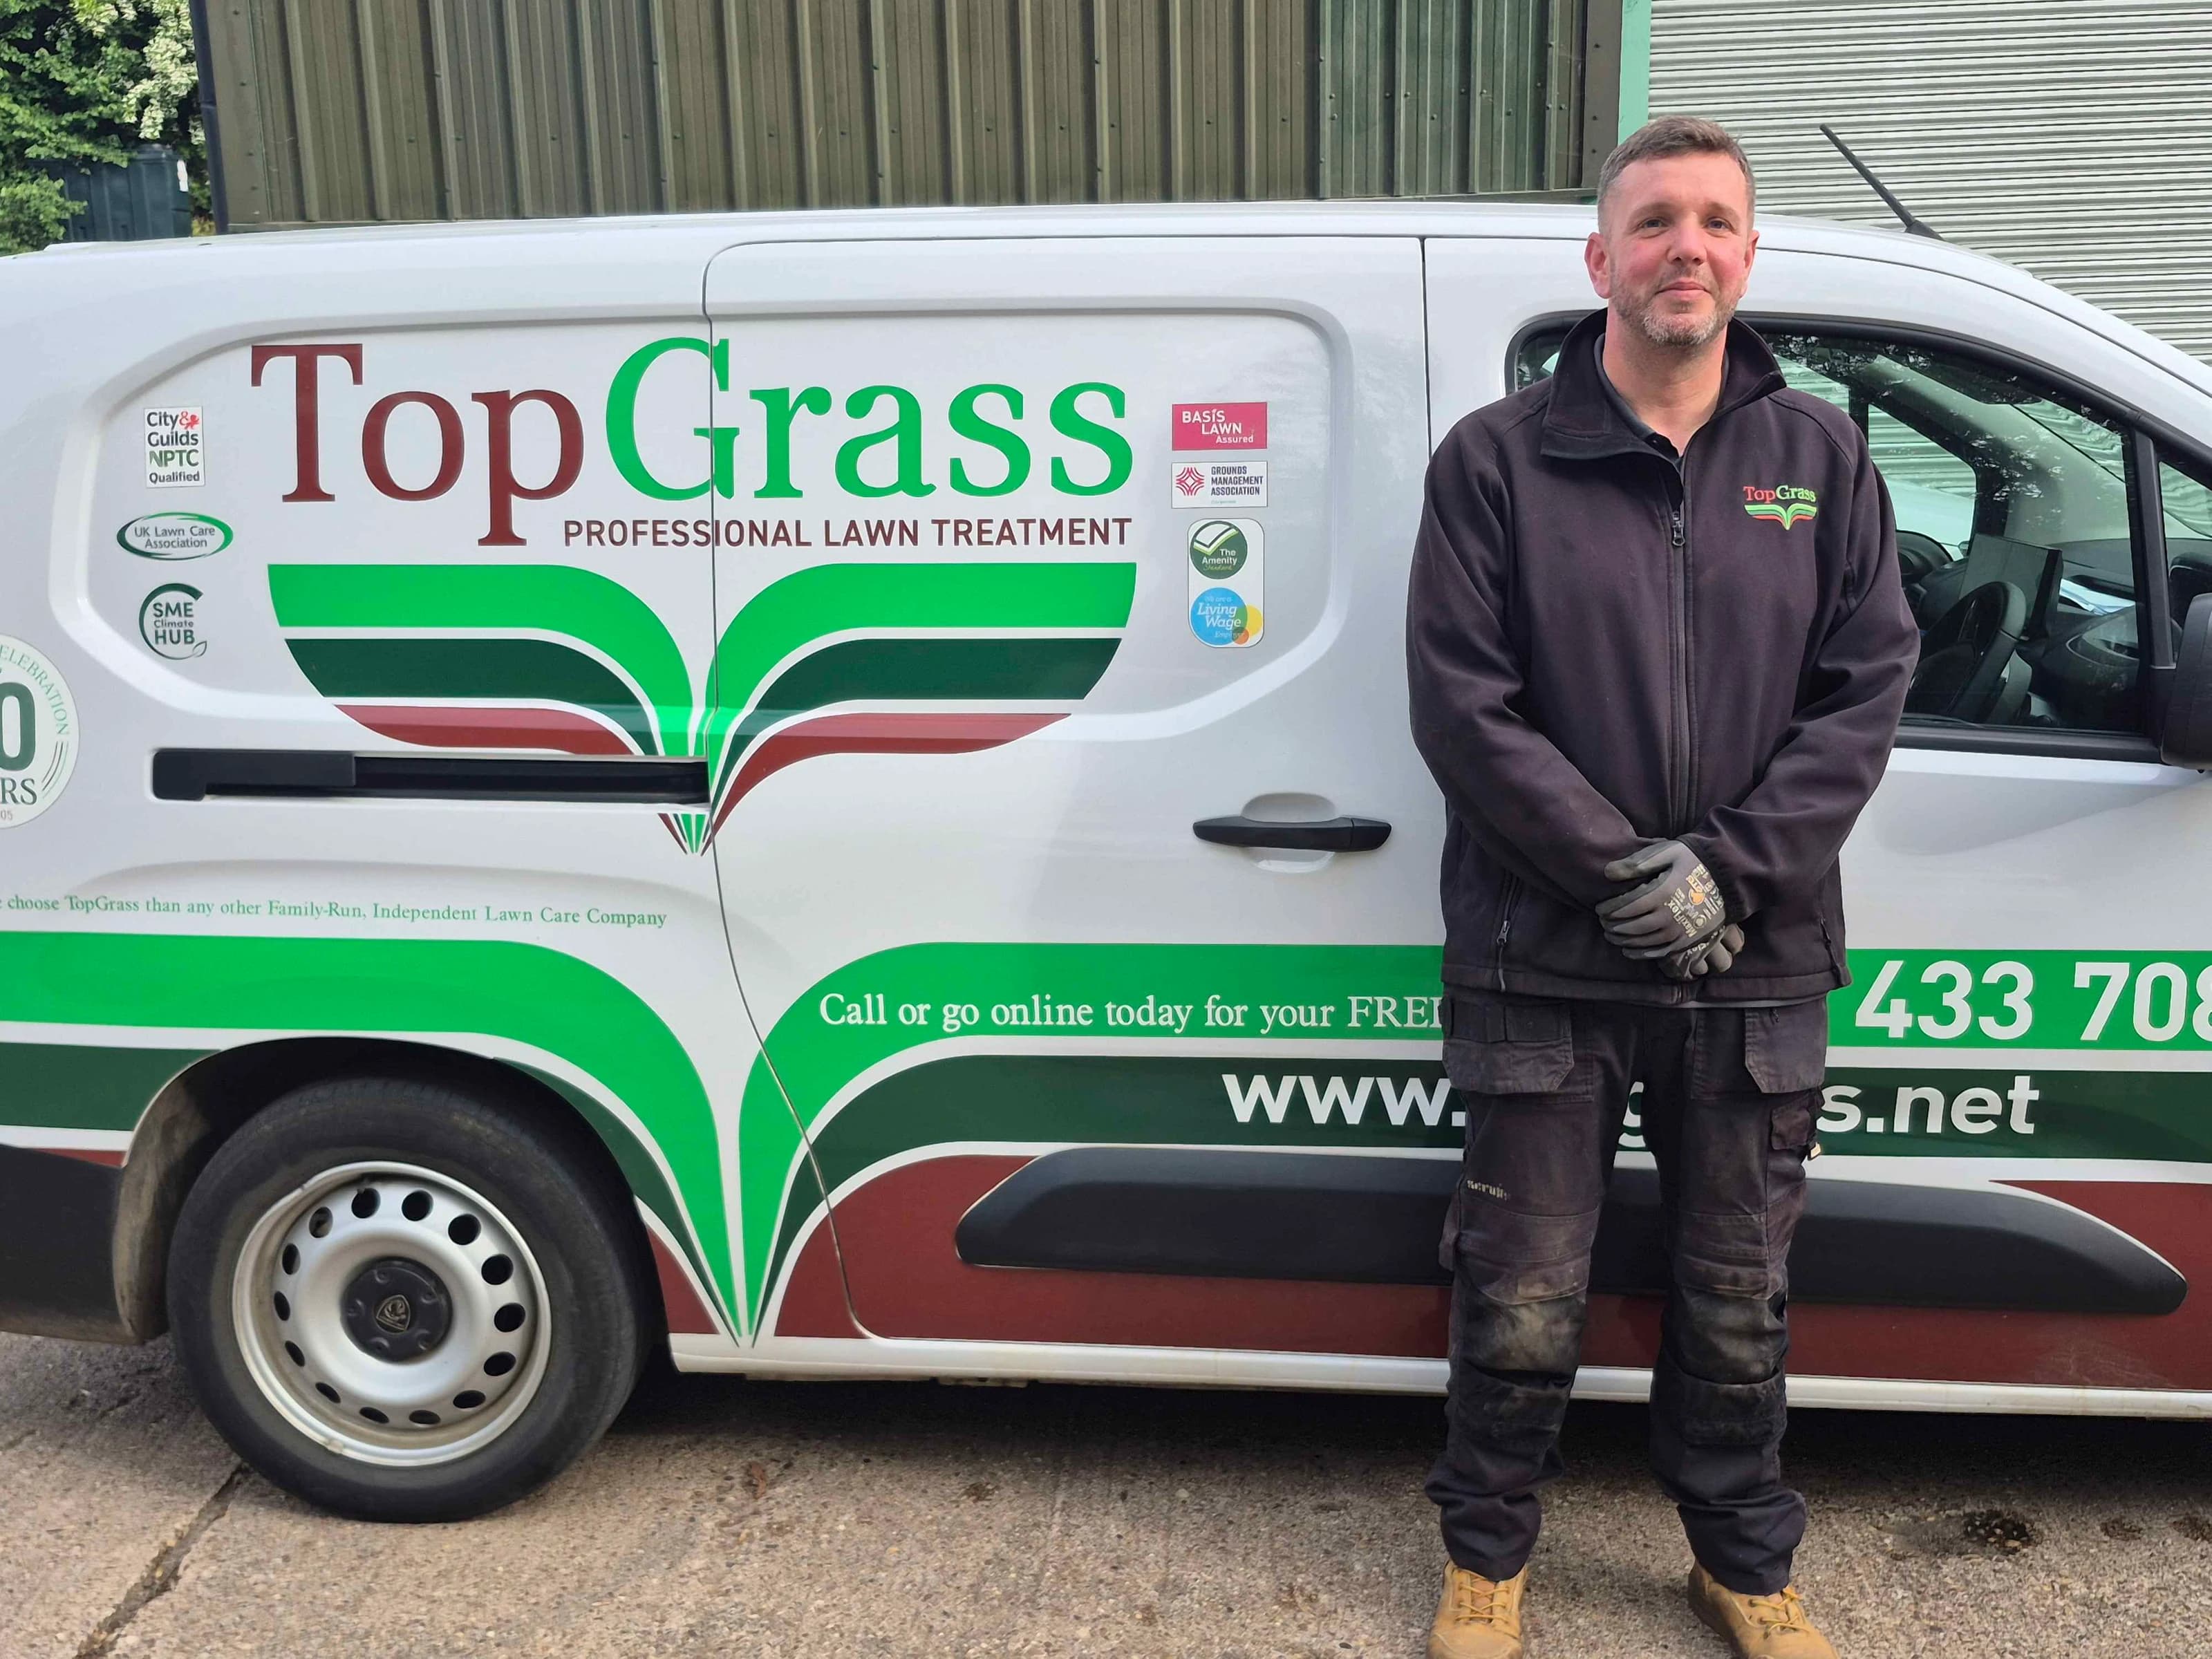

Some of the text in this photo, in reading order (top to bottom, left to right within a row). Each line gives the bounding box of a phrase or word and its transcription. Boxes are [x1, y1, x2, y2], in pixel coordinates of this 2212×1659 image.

[1201, 422, 1241, 434] LAWN
[147, 431, 199, 447] Guilds
[251, 337, 1134, 547] TopGrass
[1216, 434, 1253, 443] Assured
[149, 449, 199, 467] NPTC
[149, 470, 200, 484] Qualified
[1211, 466, 1247, 475] GROUNDS
[1211, 476, 1263, 485] MANAGEMENT
[1211, 486, 1259, 496] ASSOCIATION
[1743, 485, 1816, 503] TopGrass
[135, 525, 215, 537] UK Lawn Care
[563, 518, 1132, 547] PROFESSIONAL LAWN TREATMENT
[144, 537, 207, 548] Association
[1202, 556, 1237, 565] Amenity
[153, 603, 194, 617] SME
[1197, 602, 1237, 617] Living
[153, 619, 194, 628] Climate
[1206, 615, 1241, 630] Wage
[154, 629, 194, 645] HUB
[0, 644, 70, 735] ELEBRATION
[0, 682, 35, 771] 0
[0, 778, 37, 805] RS
[8, 894, 59, 911] choose
[65, 895, 139, 913] TopGrass
[146, 897, 180, 912] than
[187, 903, 214, 915] any
[221, 899, 260, 915] other
[373, 903, 476, 922] Independent
[485, 906, 533, 922] Lawn
[540, 906, 580, 924] Care
[586, 908, 668, 928] Company
[1855, 959, 2034, 1040] 433
[821, 993, 887, 1025] Call
[898, 1002, 930, 1025] or
[942, 1003, 980, 1032] go
[991, 994, 1093, 1026] online
[1105, 994, 1194, 1034] today
[1204, 994, 1248, 1027] for
[1260, 1004, 1335, 1034] your
